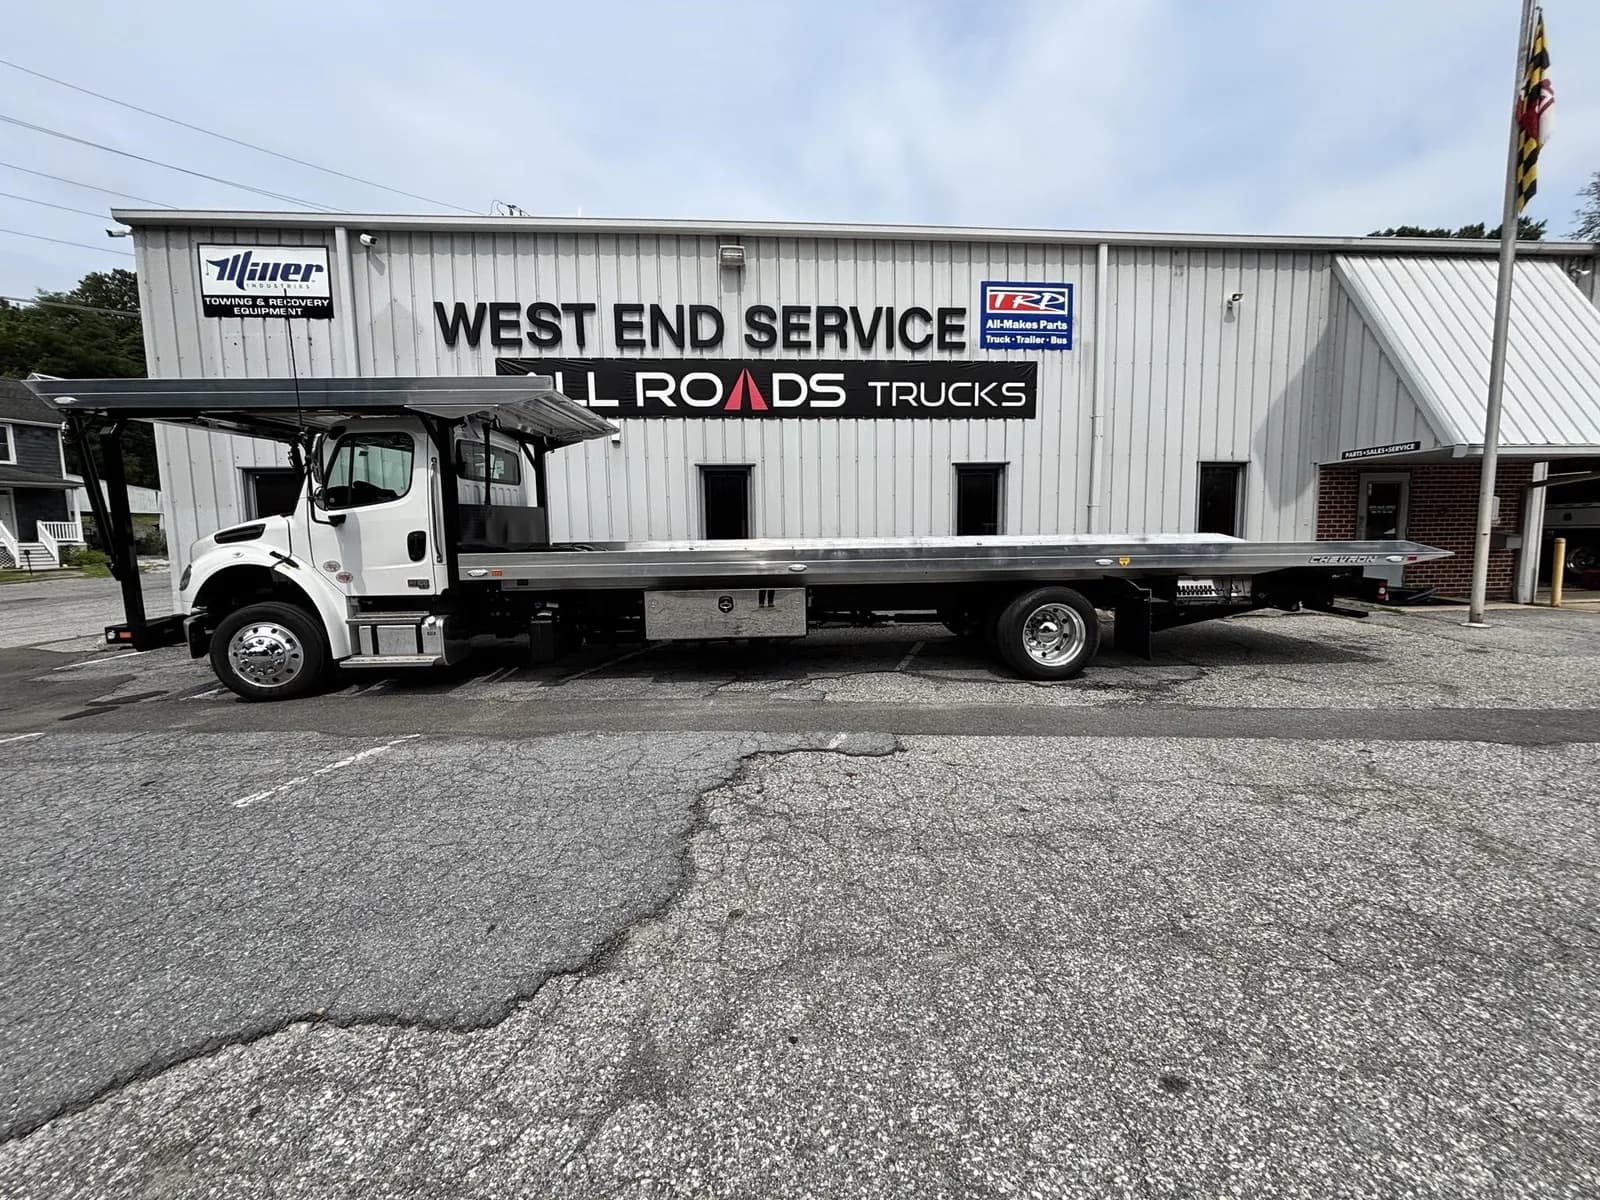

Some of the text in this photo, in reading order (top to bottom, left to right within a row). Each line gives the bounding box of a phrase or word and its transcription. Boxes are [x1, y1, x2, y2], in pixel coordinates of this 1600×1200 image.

[204, 297, 252, 305] TOWING
[269, 298, 329, 307] RECOVERY
[234, 307, 303, 315] EQUIPMENT
[433, 301, 967, 351] WEST END SERVICE
[986, 320, 1067, 330] All-Makes Parts
[986, 335, 1067, 344] Truck Trailer Bus
[527, 371, 619, 407] LL
[868, 382, 1026, 407] TRUCKS
[1309, 555, 1377, 563] CHEVRON
